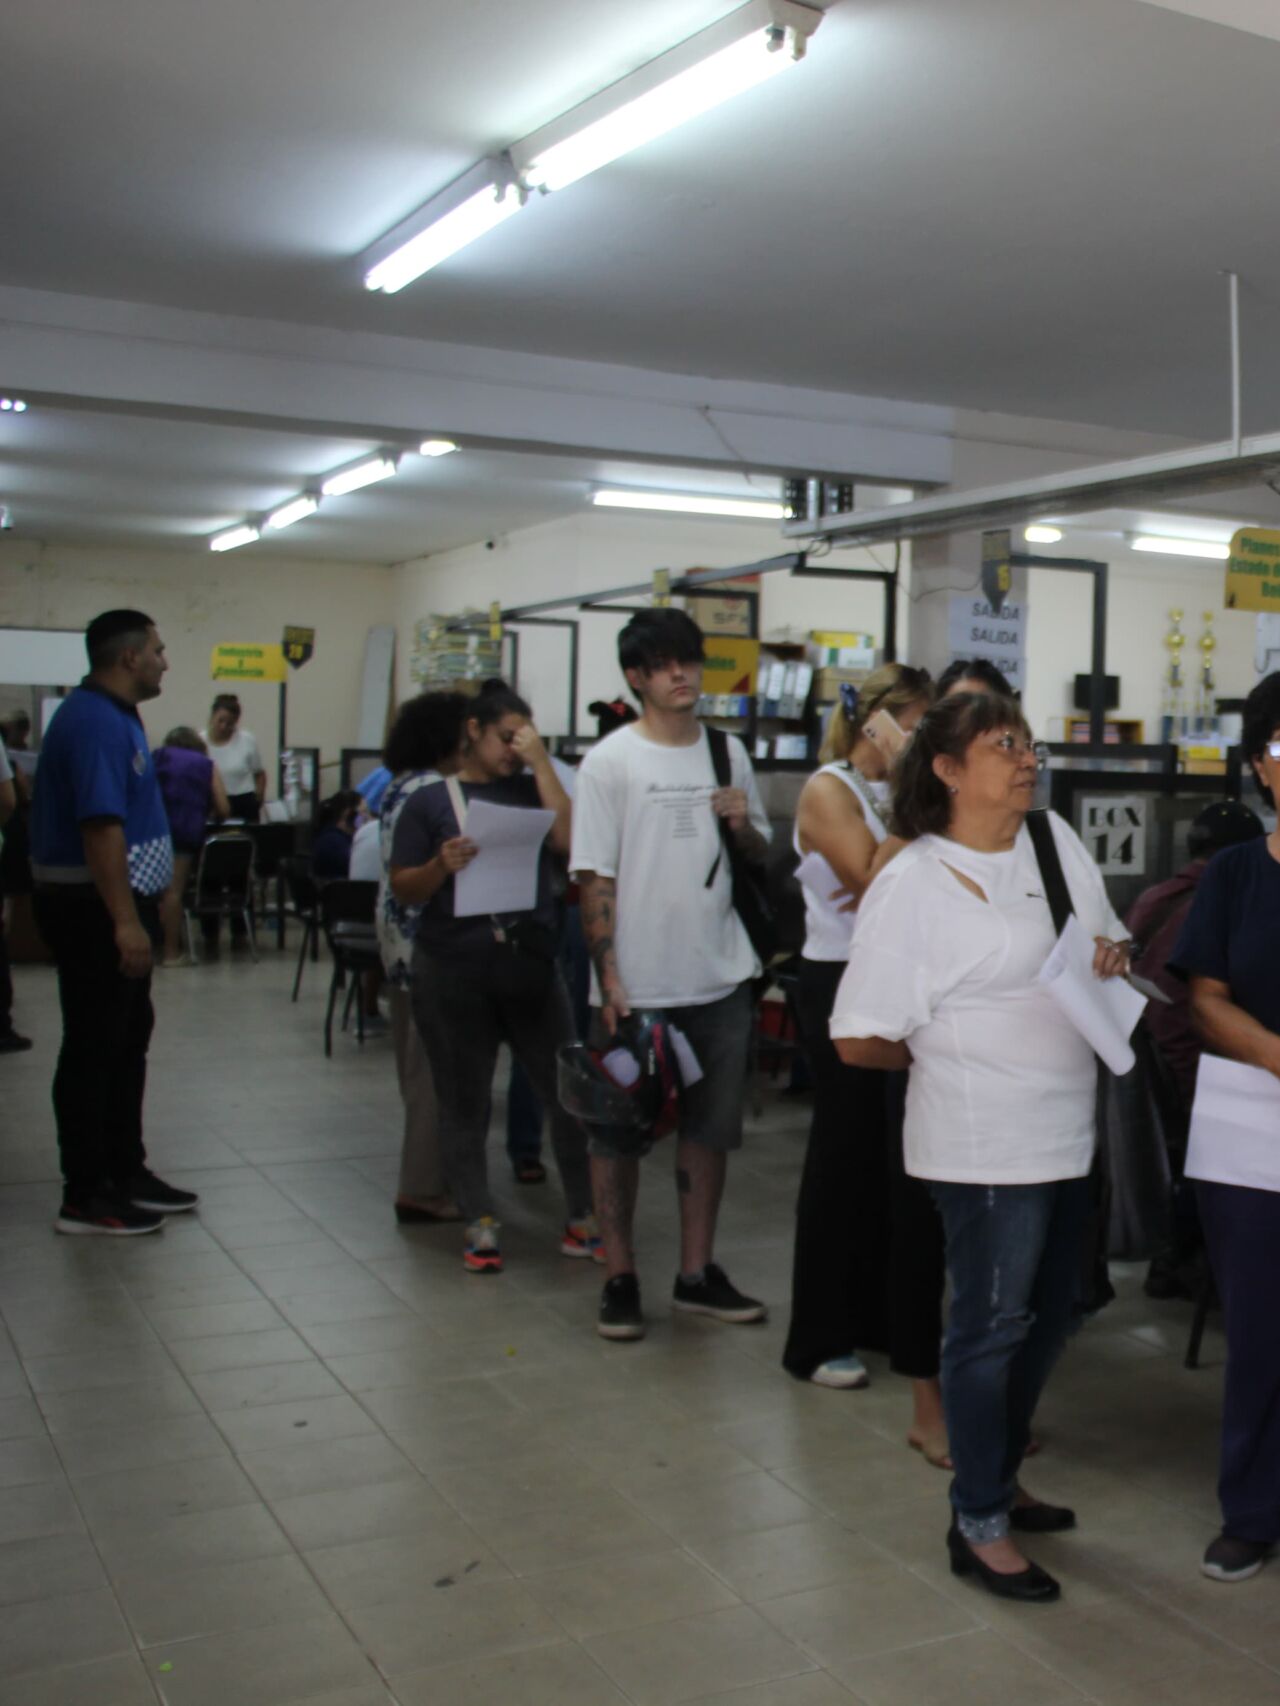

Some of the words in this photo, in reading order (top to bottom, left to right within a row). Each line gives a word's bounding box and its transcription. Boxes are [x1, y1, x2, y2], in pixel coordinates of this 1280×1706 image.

[1230, 557, 1270, 576] Estado
[970, 627, 1019, 645] SALIDA
[1089, 807, 1143, 828] BOX
[1092, 832, 1137, 865] 14
